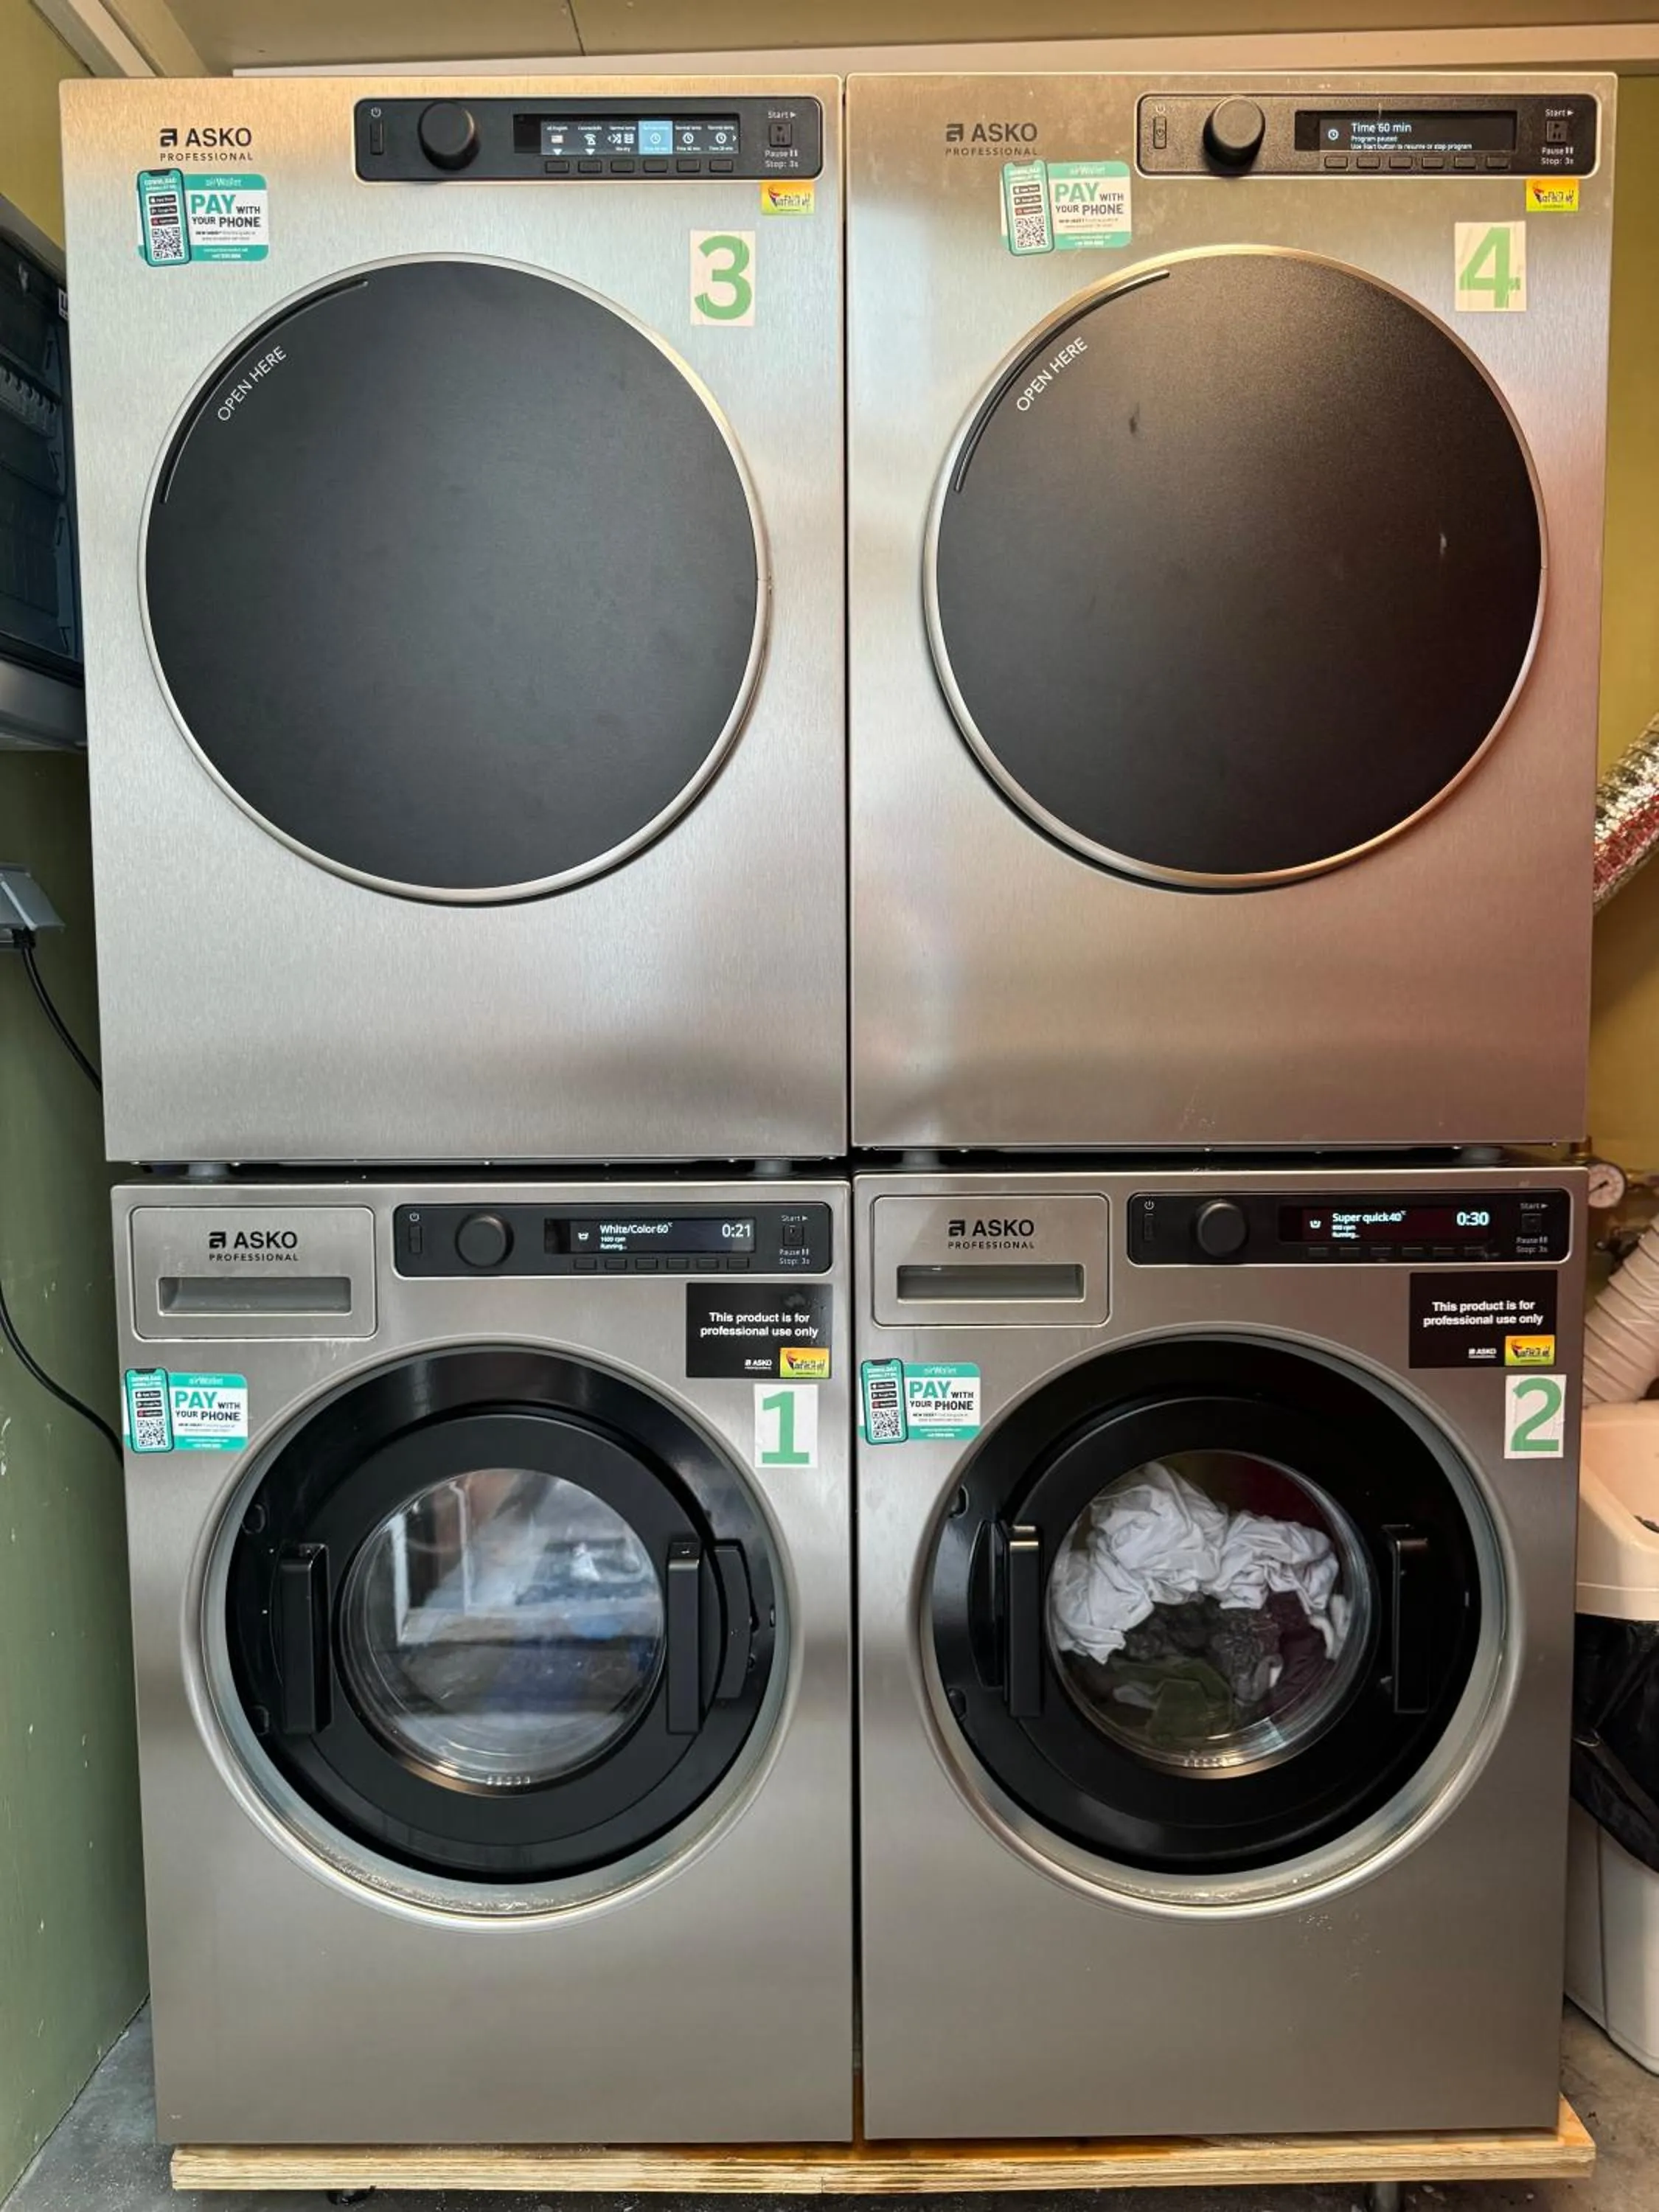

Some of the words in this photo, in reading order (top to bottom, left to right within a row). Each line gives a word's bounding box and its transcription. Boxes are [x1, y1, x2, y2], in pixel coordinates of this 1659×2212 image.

[1545, 109, 1565, 117] Start
[971, 123, 1038, 142] ASKO
[1351, 122, 1375, 133] Time
[1378, 122, 1391, 133] 60
[1393, 122, 1412, 133] min
[185, 128, 252, 147] ASKO
[160, 152, 253, 161] PROFESSIONAL
[945, 147, 1038, 156] PROFESSIONAL
[1542, 147, 1564, 155] Pause
[765, 160, 787, 169] Stop:
[790, 160, 799, 168] 3s
[1541, 157, 1562, 166] Stop:
[1055, 182, 1099, 202] PAY
[1099, 192, 1124, 201] WITH
[191, 195, 236, 215] PAY
[236, 206, 260, 214] WITH
[1056, 205, 1079, 213] YOUR
[1082, 204, 1124, 215] PHONE
[192, 217, 216, 225] YOUR
[219, 217, 261, 228] PHONE
[1460, 227, 1520, 308] 4
[695, 234, 752, 320] 3
[1017, 369, 1053, 411] OPEN
[1049, 336, 1088, 373] HERE
[218, 379, 253, 421] OPEN
[248, 345, 287, 383] HERE
[1332, 1213, 1361, 1224] Super
[1362, 1211, 1388, 1224] quick
[1456, 1211, 1490, 1227] 0:30
[599, 1224, 656, 1234] White/Color
[722, 1224, 751, 1239] 0:21
[973, 1220, 1034, 1237] ASKO
[233, 1231, 298, 1249] ASKO
[948, 1241, 1034, 1249] PROFESSIONAL
[209, 1253, 299, 1262] PROFESSIONAL
[1432, 1301, 1458, 1312] This
[1459, 1301, 1503, 1312] product
[1506, 1301, 1517, 1310] is
[1519, 1300, 1536, 1310] for
[709, 1312, 734, 1323] This
[736, 1312, 779, 1324] product
[782, 1312, 791, 1322] is
[795, 1312, 810, 1323] for
[1423, 1315, 1493, 1327] professional
[1496, 1315, 1517, 1324] use
[1519, 1314, 1544, 1326] only
[700, 1326, 769, 1338] professional
[772, 1328, 792, 1337] use
[795, 1326, 819, 1339] only
[909, 1381, 951, 1399] PAY
[175, 1391, 218, 1408] PAY
[934, 1401, 974, 1411] PHONE
[175, 1410, 198, 1418] YOUR
[201, 1411, 240, 1421] PHONE
[1511, 1377, 1562, 1452] 2
[762, 1391, 810, 1464] 1
